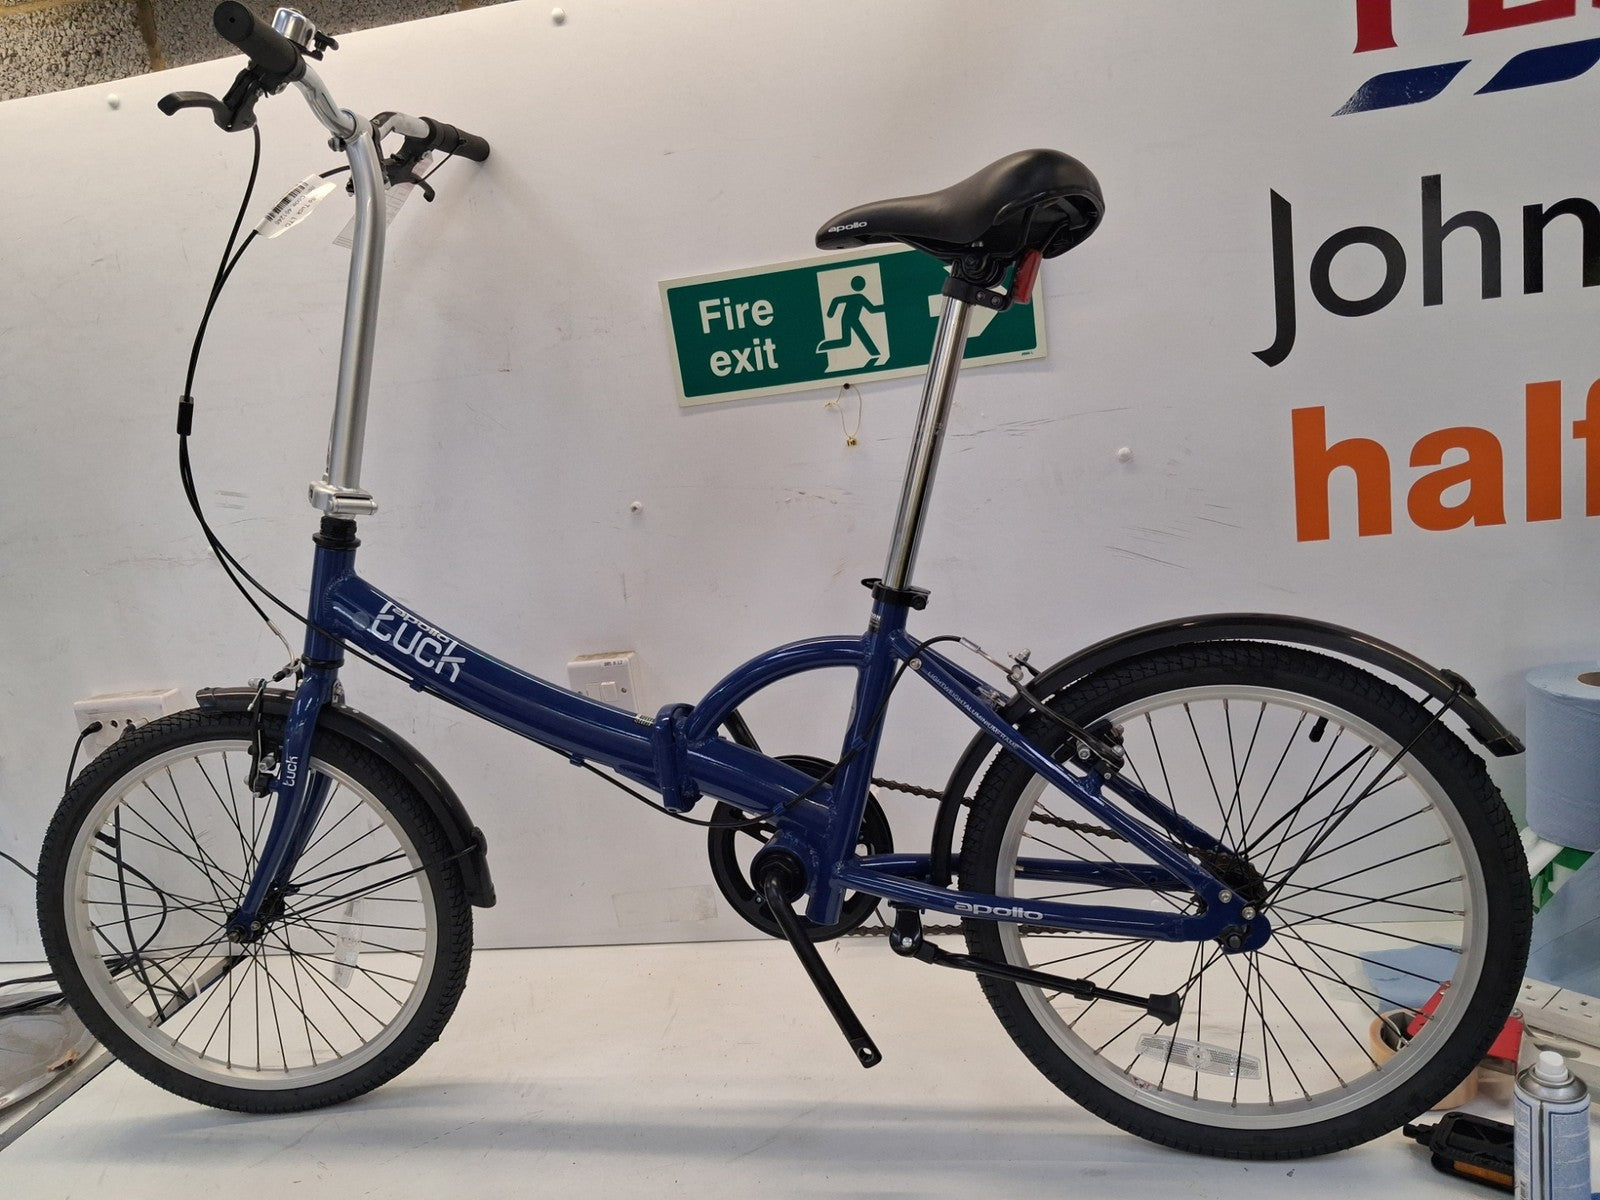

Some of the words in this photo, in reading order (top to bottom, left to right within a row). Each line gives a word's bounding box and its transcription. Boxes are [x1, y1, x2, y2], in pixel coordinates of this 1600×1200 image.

[828, 221, 868, 233] apollo
[1251, 174, 1600, 367] John
[698, 297, 774, 334] Fire
[709, 337, 779, 377] exit
[371, 602, 466, 683] tuck
[392, 607, 450, 644] apollo
[282, 755, 299, 787] tuck
[954, 901, 1044, 921] apollo
